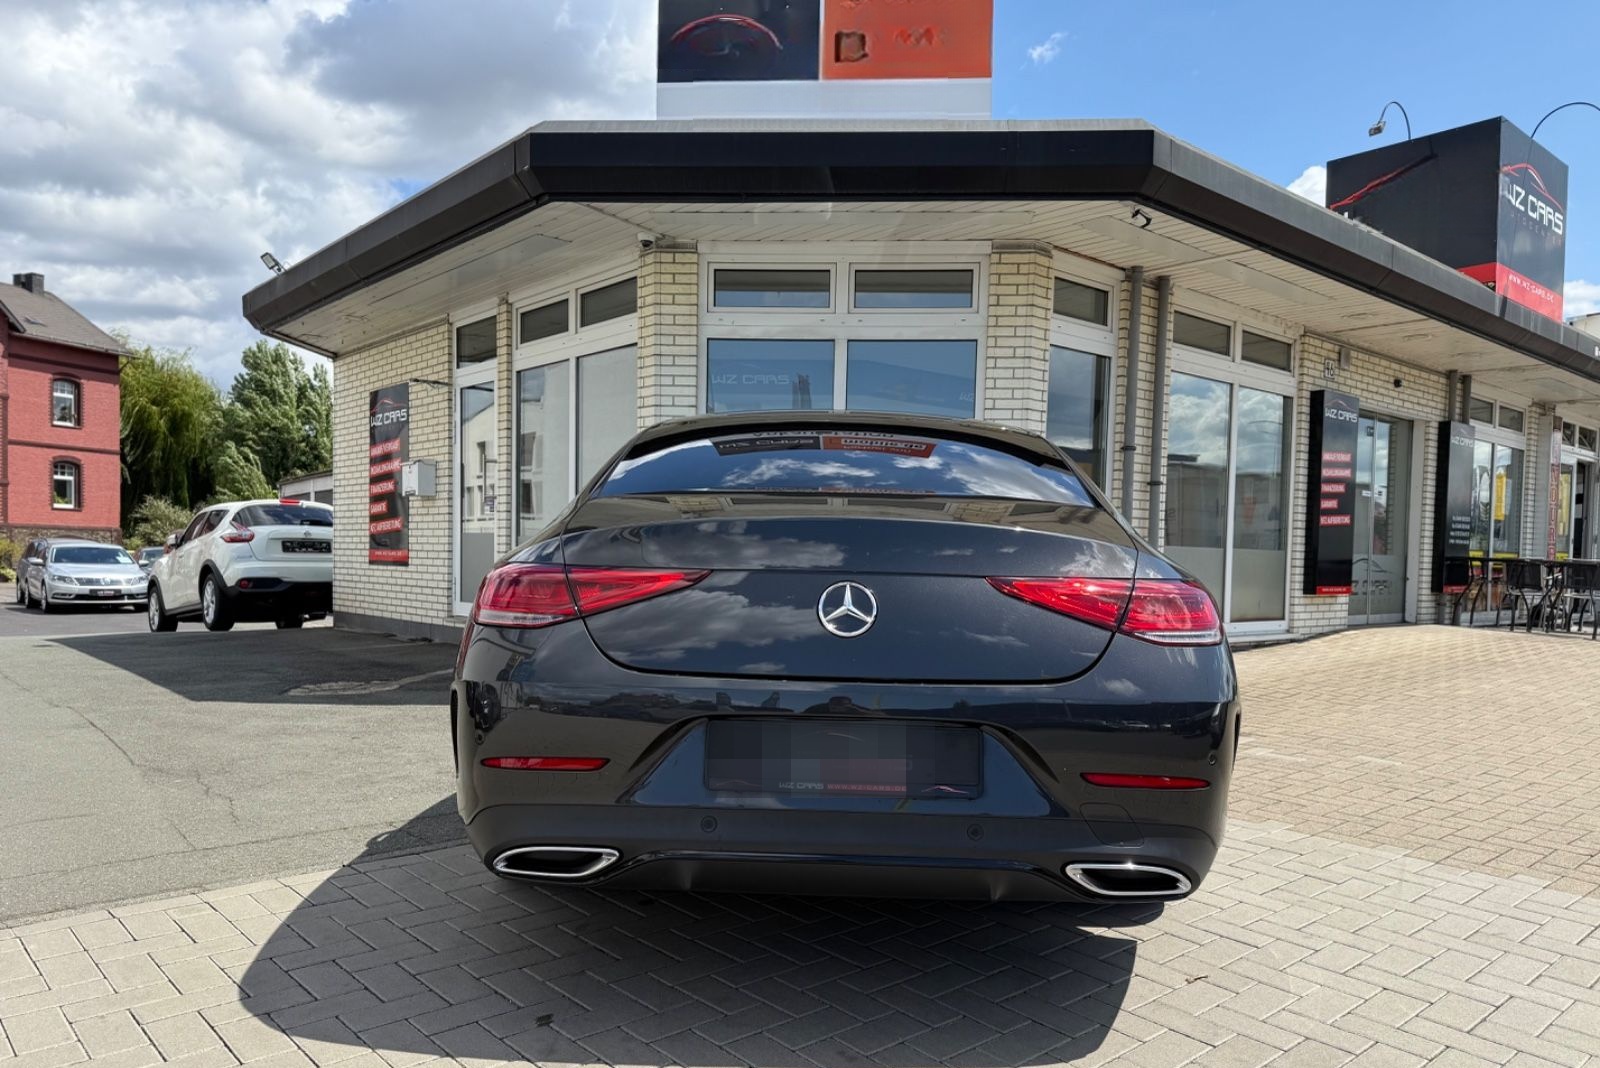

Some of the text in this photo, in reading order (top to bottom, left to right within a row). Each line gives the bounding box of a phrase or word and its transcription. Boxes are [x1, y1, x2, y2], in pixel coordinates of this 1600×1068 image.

[1527, 194, 1563, 236] CARS
[711, 374, 791, 385] WZ CARS
[383, 409, 407, 425] CARS
[1338, 410, 1358, 423] CARS
[796, 782, 824, 790] CARS
